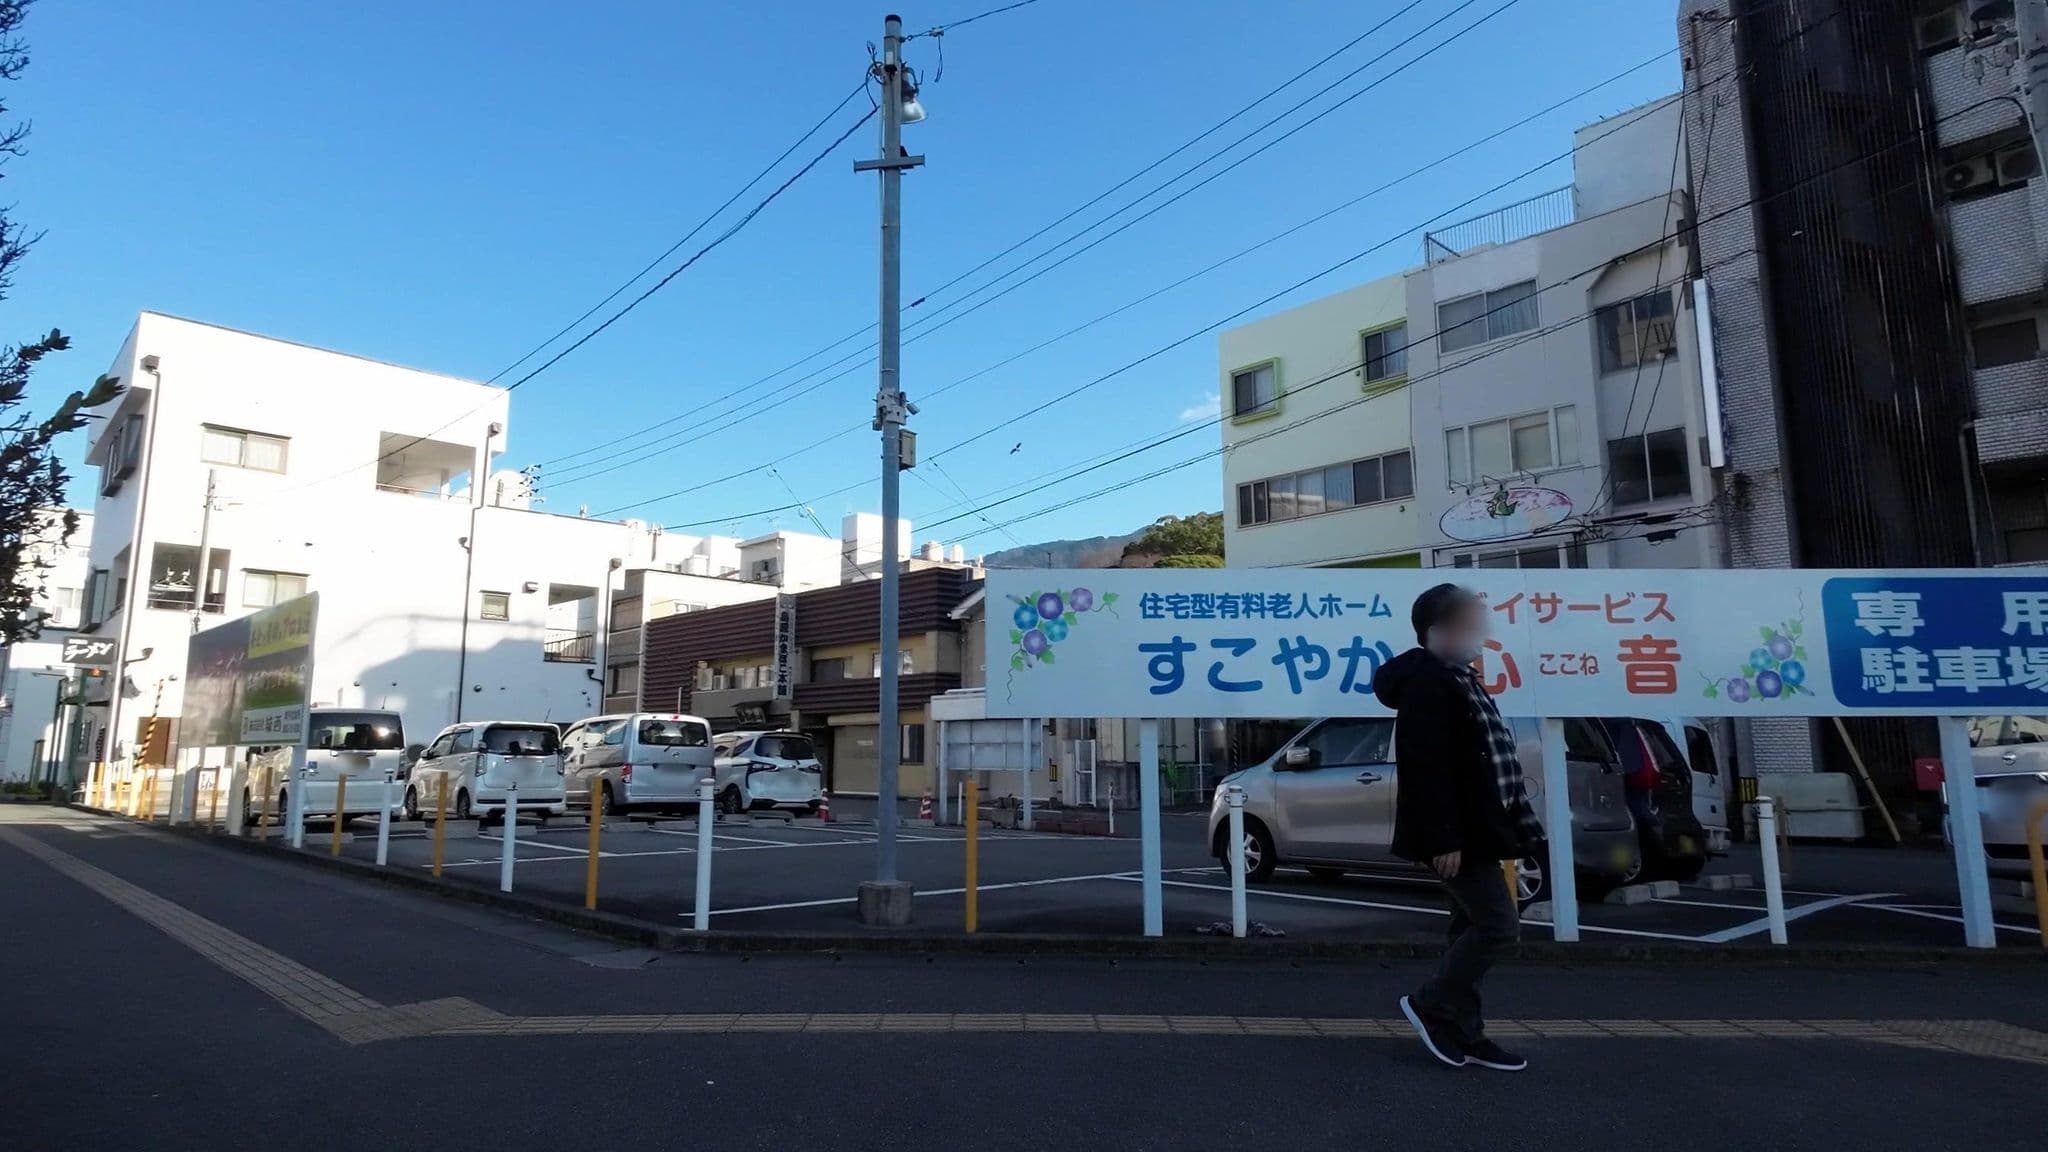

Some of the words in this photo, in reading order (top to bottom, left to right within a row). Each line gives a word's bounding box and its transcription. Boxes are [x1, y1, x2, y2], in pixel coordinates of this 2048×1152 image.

[1138, 592, 1393, 620] 住宅型有料老人ホーム
[1477, 591, 1676, 625] イサービス
[64, 641, 114, 662] ラーメン
[1137, 635, 1395, 695] すこやか
[1538, 651, 1600, 676] ここね
[1616, 633, 1682, 695] 音
